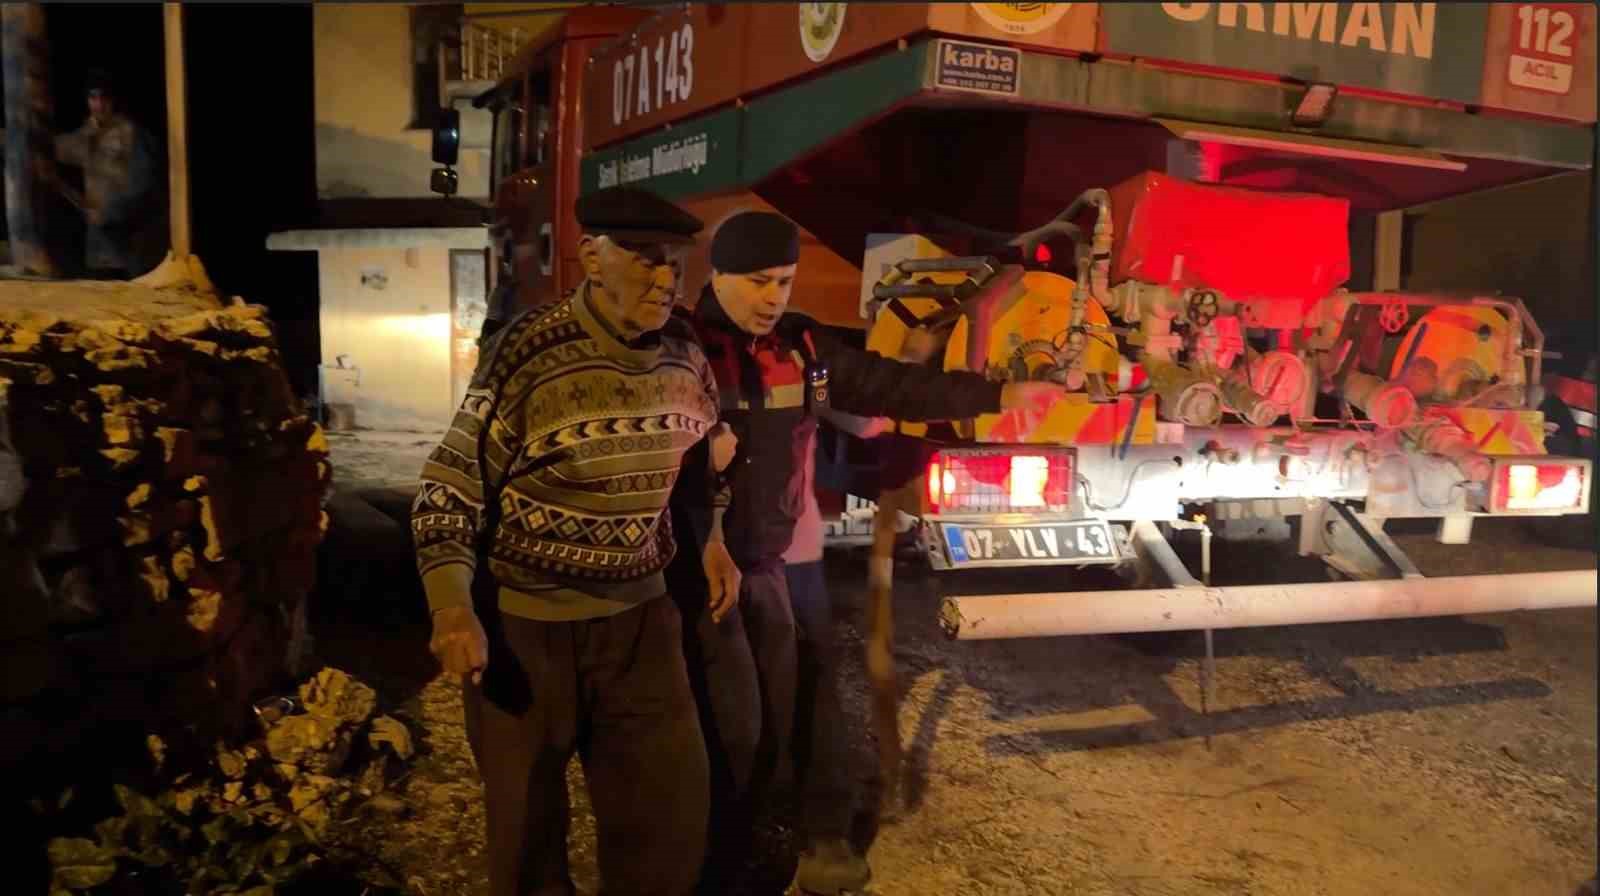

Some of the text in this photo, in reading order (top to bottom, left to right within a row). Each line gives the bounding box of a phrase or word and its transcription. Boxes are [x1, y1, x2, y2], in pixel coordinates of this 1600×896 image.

[1519, 6, 1574, 56] 112
[944, 44, 1014, 71] karba
[964, 526, 1110, 558] 07 YLV 43
